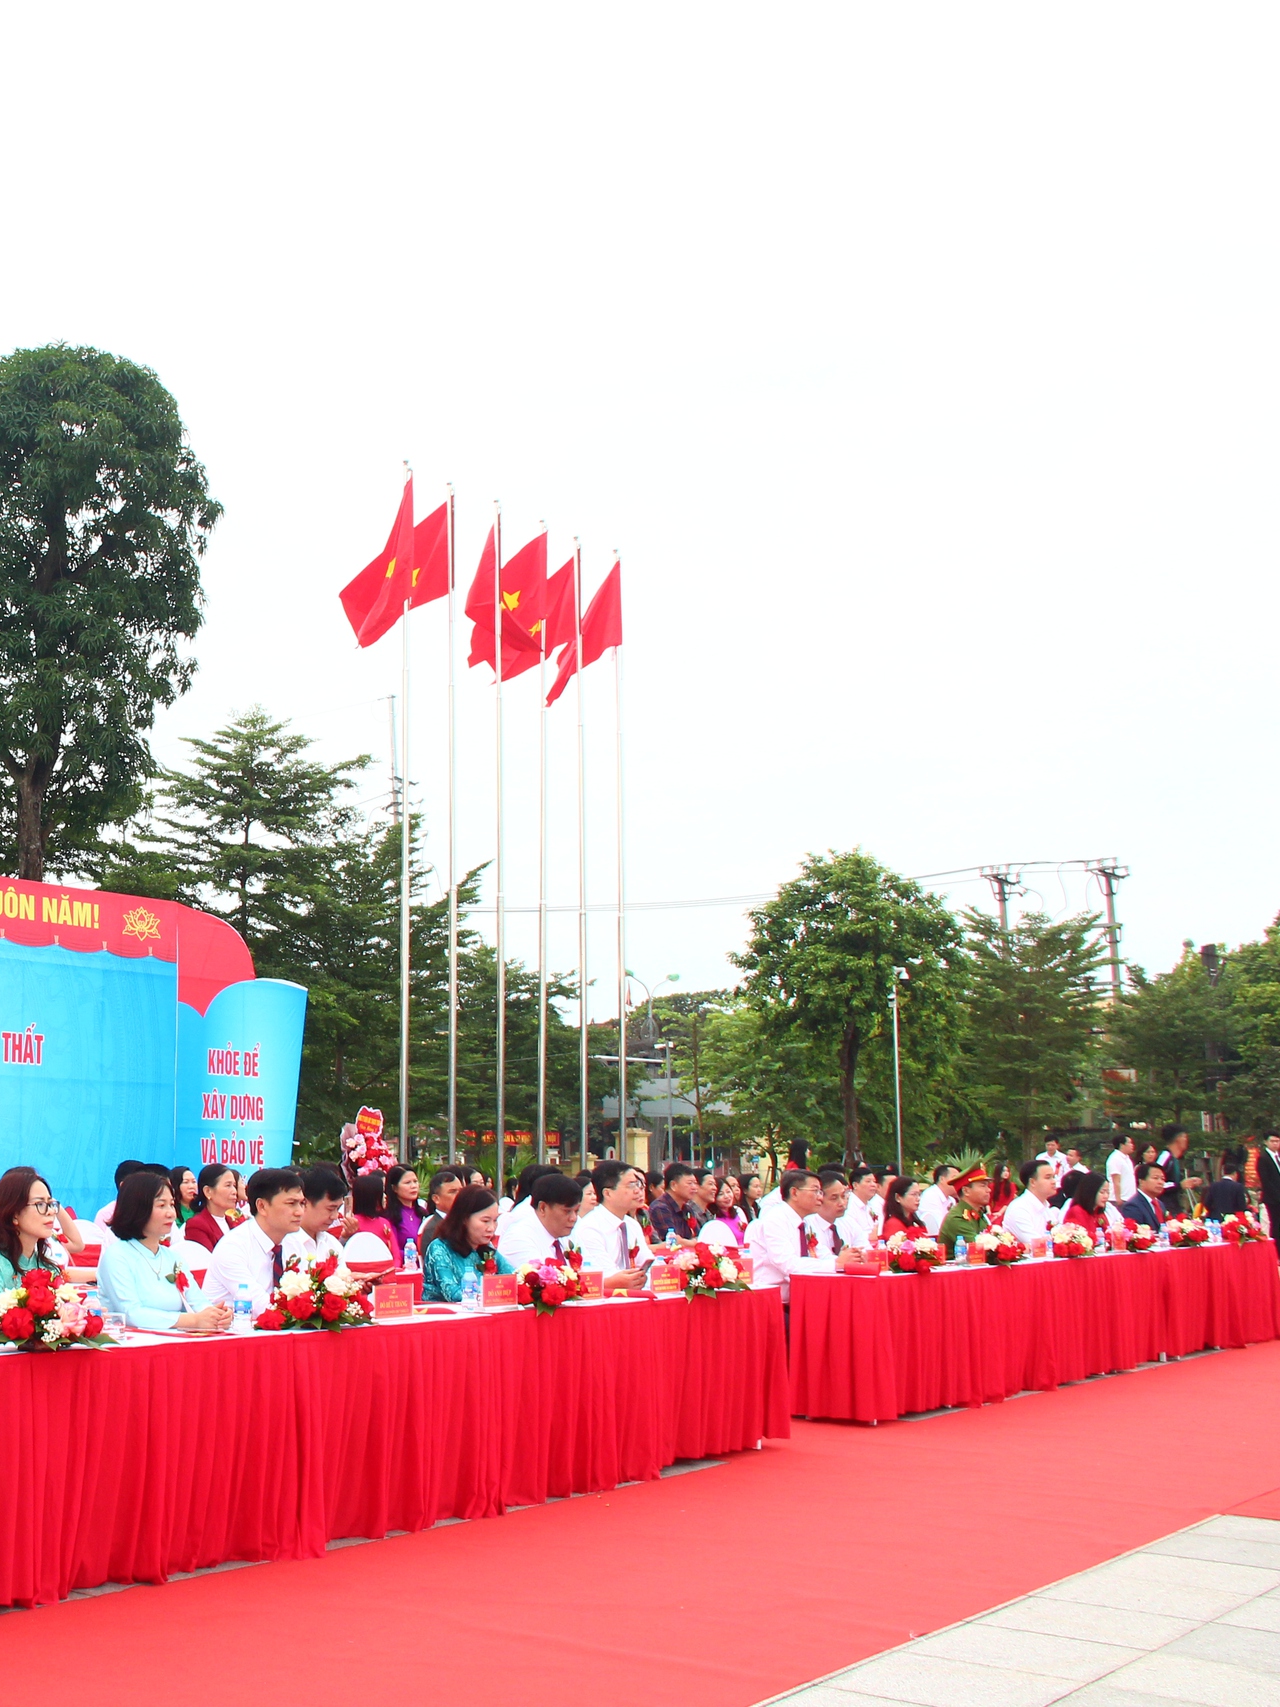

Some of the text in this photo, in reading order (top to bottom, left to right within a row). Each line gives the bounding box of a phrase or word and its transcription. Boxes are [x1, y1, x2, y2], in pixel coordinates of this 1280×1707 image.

[42, 893, 100, 929] NĂM!
[2, 1023, 44, 1065] THẤT
[208, 1042, 260, 1077] KHỎE ĐỂ
[202, 1089, 264, 1126] XÂY DỰNG
[201, 1131, 264, 1171] VÀ BẢO VỆ
